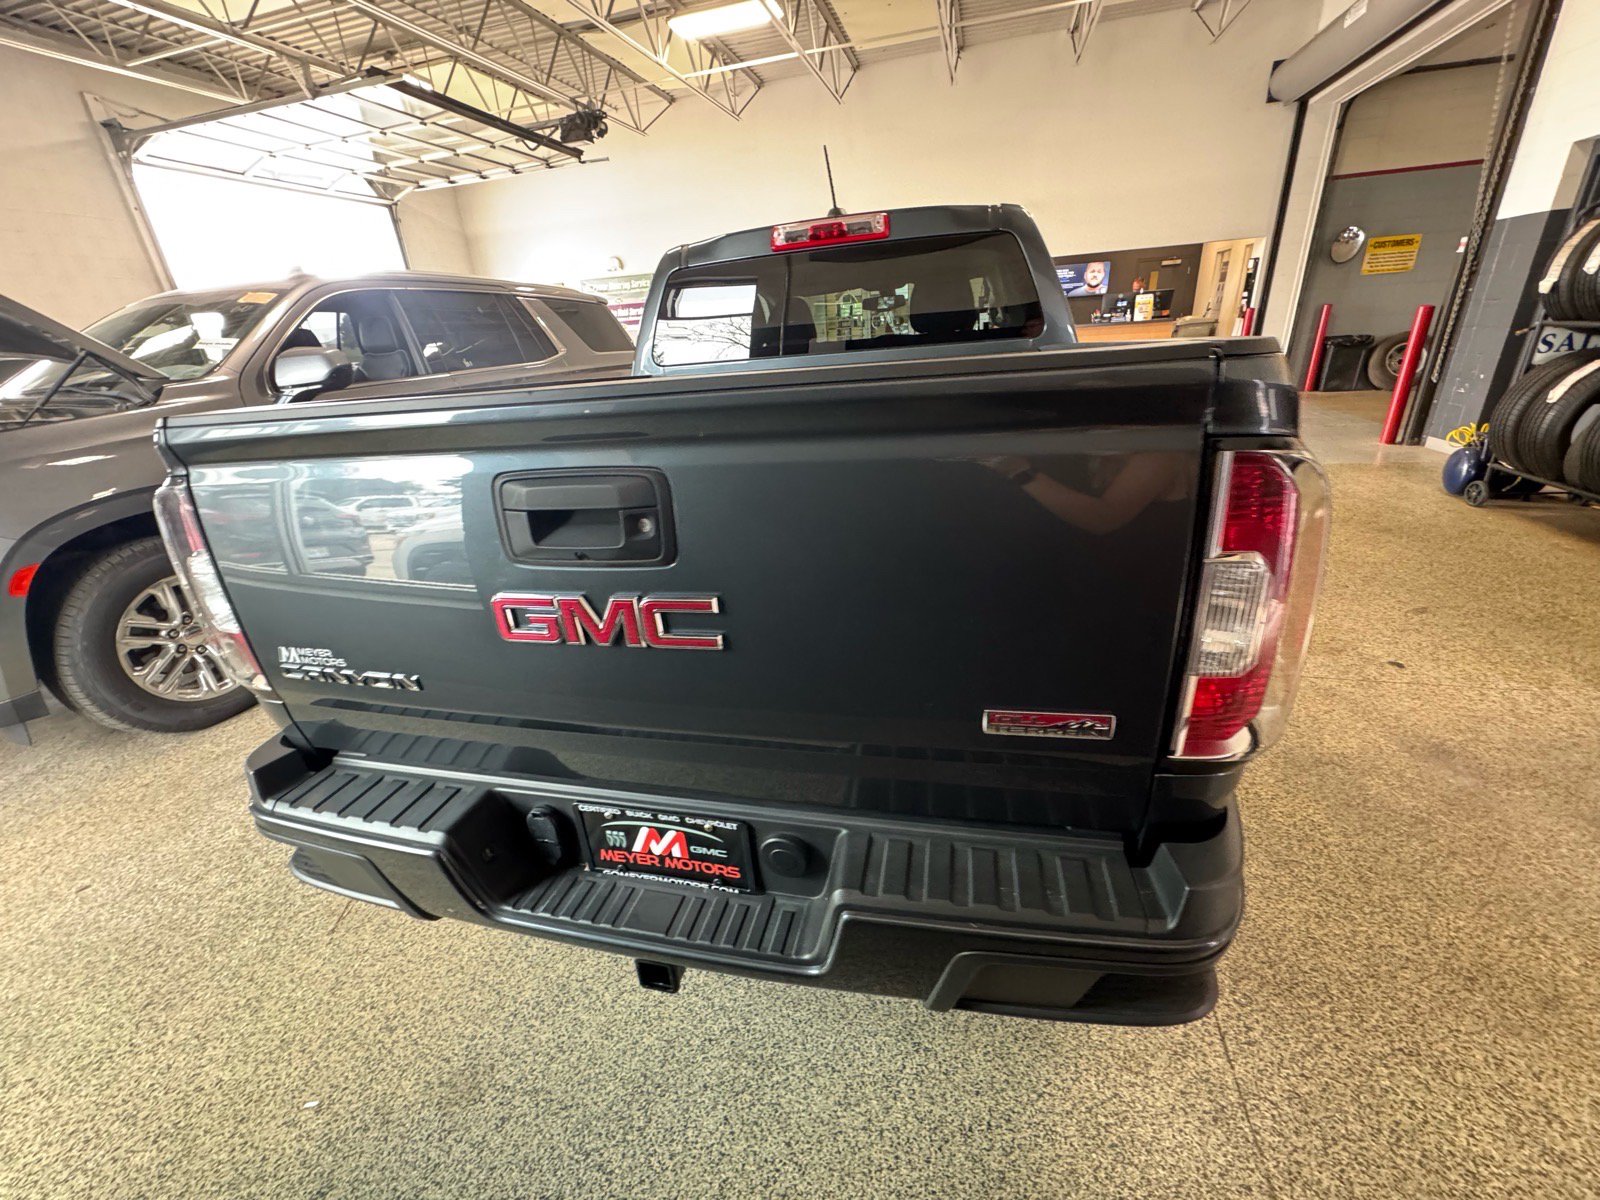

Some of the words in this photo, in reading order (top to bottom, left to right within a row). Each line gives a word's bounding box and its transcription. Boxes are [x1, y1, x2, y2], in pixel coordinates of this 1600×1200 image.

[490, 590, 727, 650] GMC
[296, 647, 333, 658] MEYER
[299, 656, 348, 667] MOTORS
[279, 663, 424, 691] CANYON
[625, 809, 654, 820] BUICK
[657, 813, 681, 823] GMC
[684, 816, 738, 831] CHEVROLET
[689, 845, 728, 858] GMC
[600, 848, 661, 868] MEYER
[664, 856, 742, 879] MOTORS
[602, 870, 740, 894] GOMEYERMOTORSCOM
